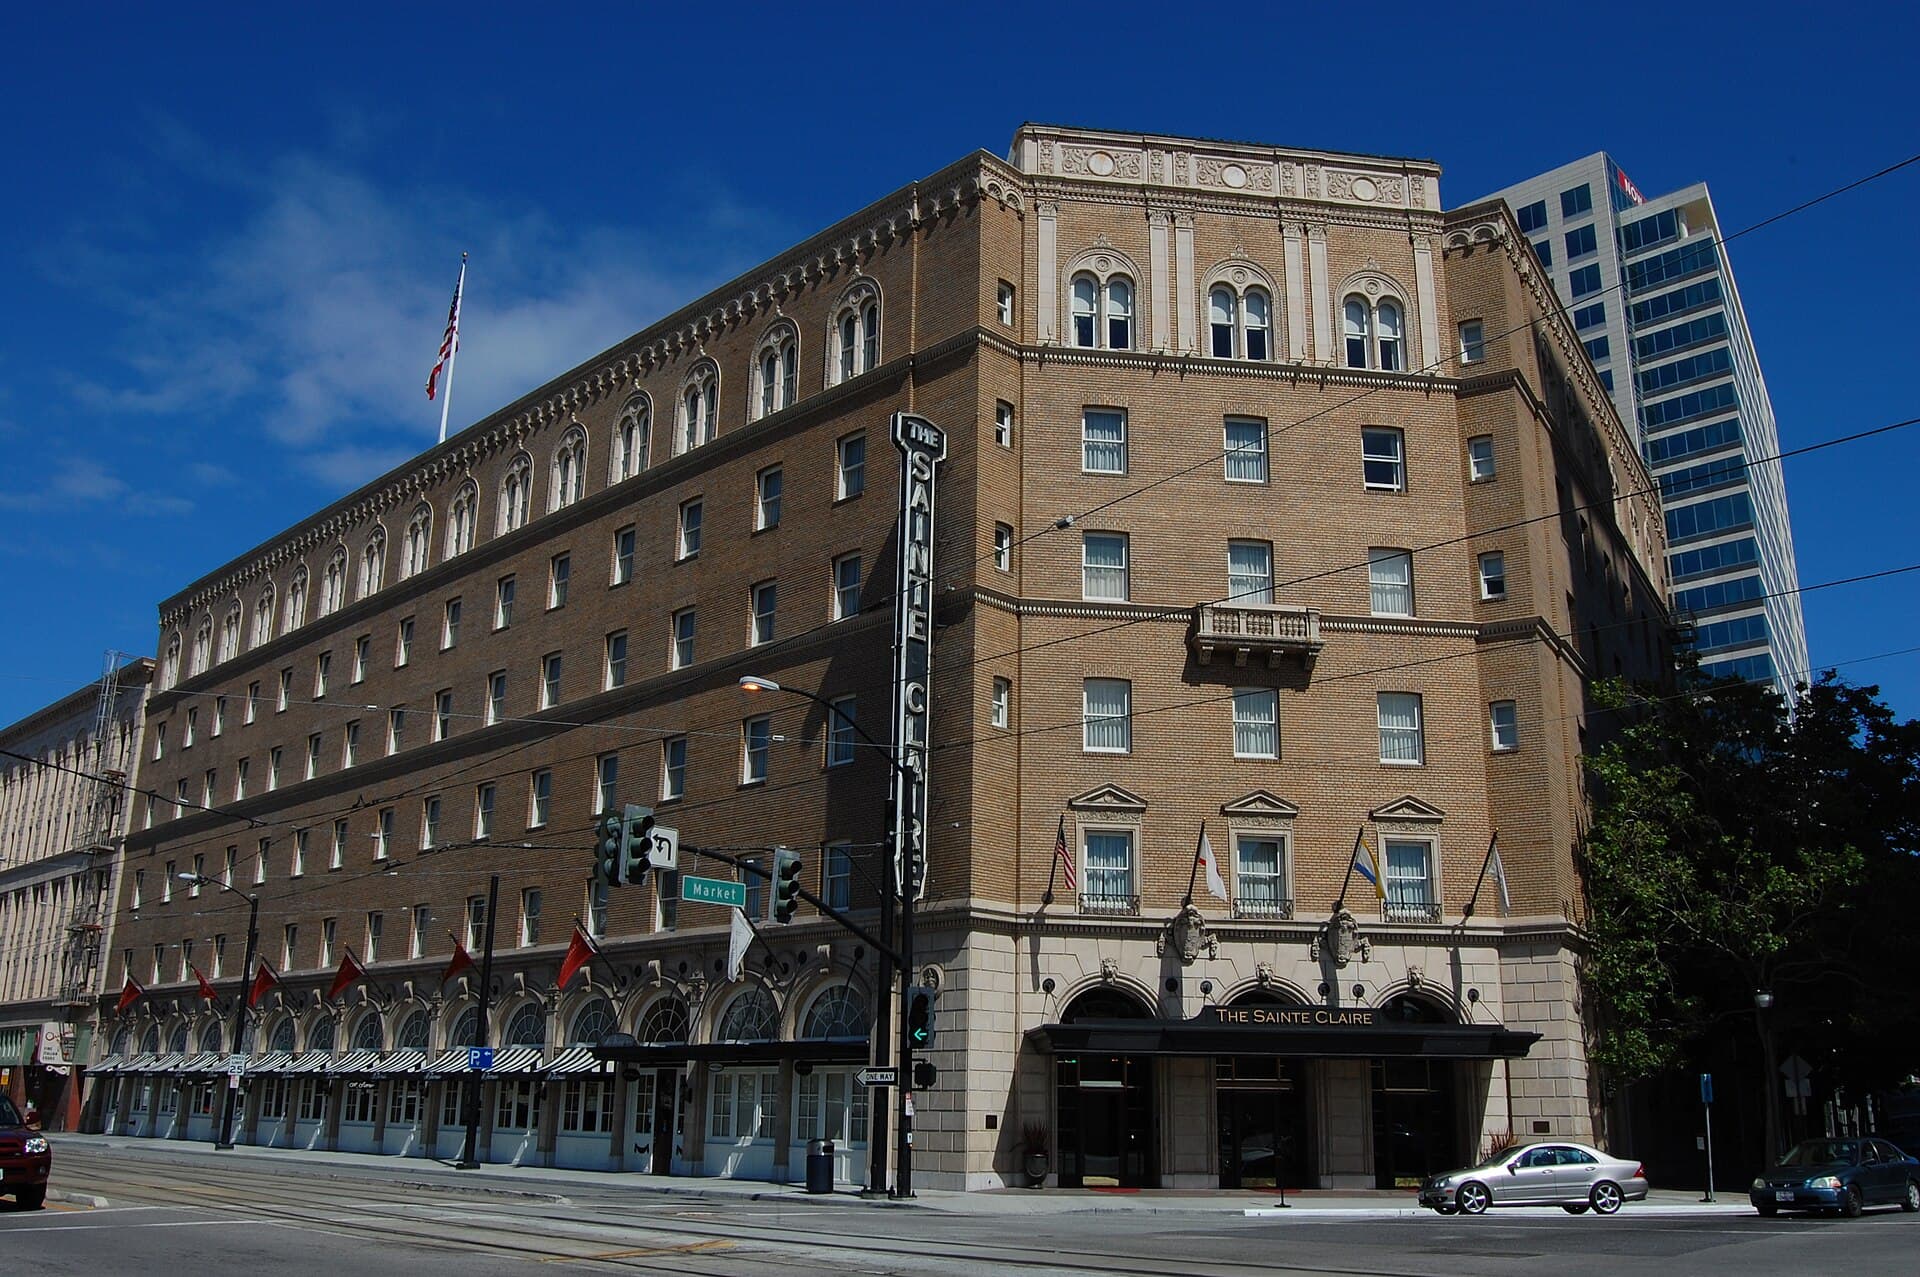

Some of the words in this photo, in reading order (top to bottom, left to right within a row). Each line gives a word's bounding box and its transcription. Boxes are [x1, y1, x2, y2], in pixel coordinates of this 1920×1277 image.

[907, 420, 939, 448] THE
[907, 451, 931, 642] SAINTE
[693, 883, 736, 900] Market
[1215, 1008, 1249, 1023] THE
[1253, 1009, 1311, 1024] SAINTE
[1315, 1010, 1373, 1025] CLAIRE
[470, 1050, 481, 1065] P
[230, 1065, 243, 1073] 25
